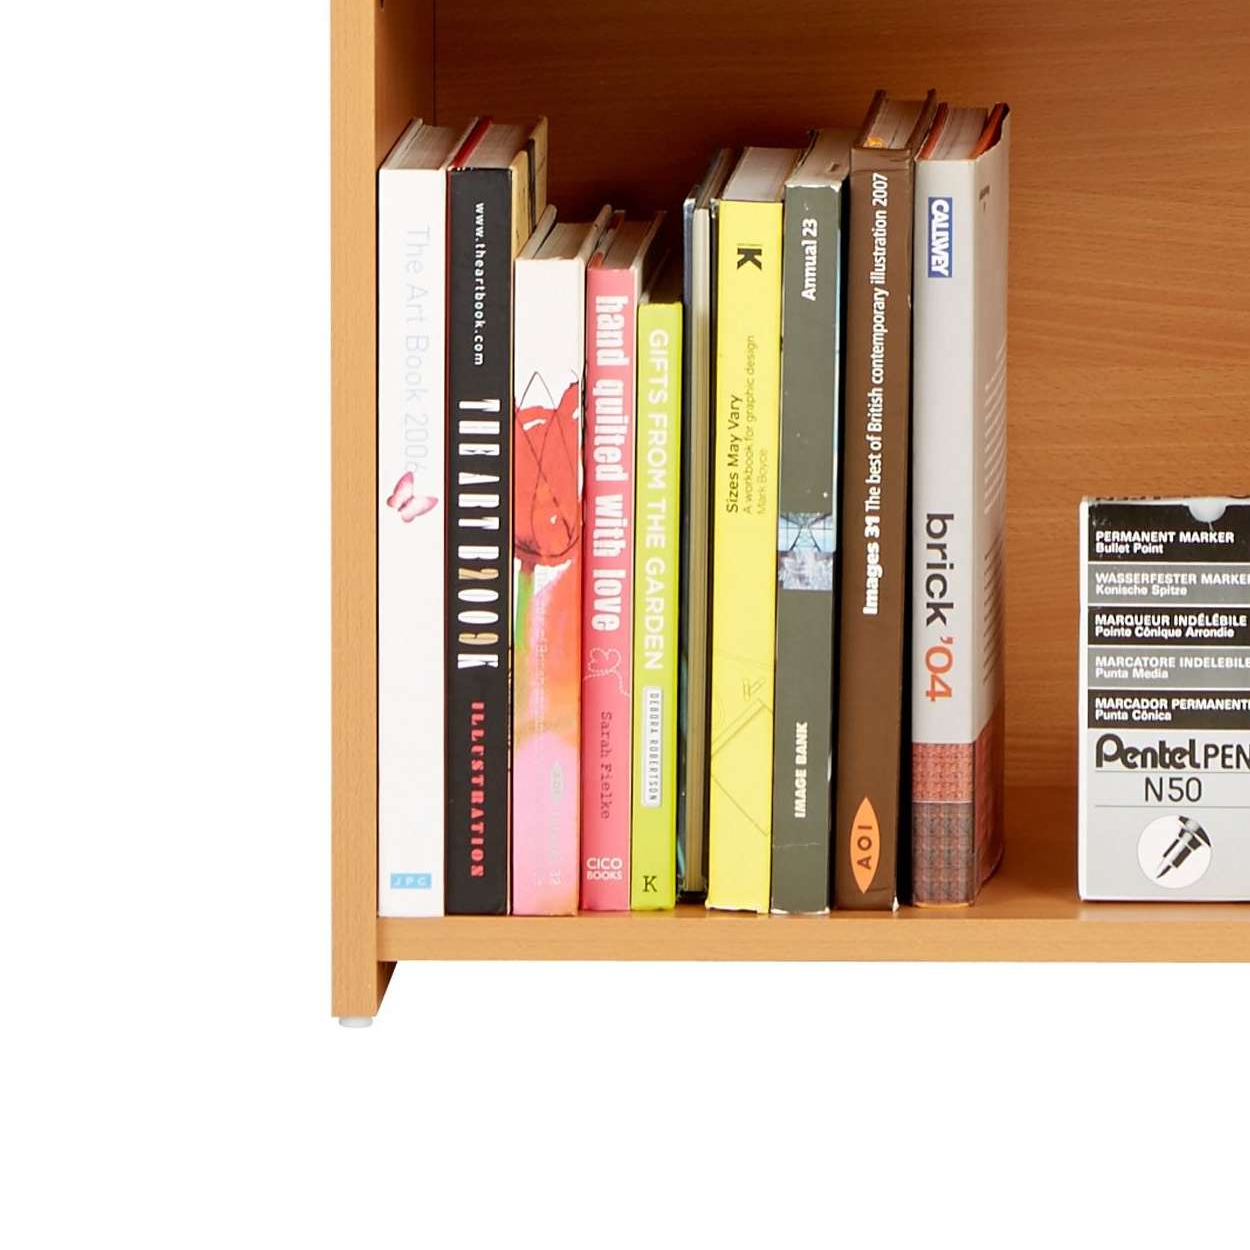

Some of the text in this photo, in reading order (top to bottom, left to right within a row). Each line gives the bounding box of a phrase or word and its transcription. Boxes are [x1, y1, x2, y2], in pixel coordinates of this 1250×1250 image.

[404, 225, 430, 275] The
[736, 247, 763, 270] K
[801, 218, 819, 300] Annual 23
[931, 199, 949, 277] CALLWEY
[404, 283, 429, 326] Art
[474, 202, 486, 366] www.theartbook.com
[404, 334, 429, 402] Book
[863, 173, 889, 615] Images 31 The best of British contemporary illustration 2007
[591, 296, 629, 632] hand quilted with love
[726, 394, 744, 514] Sizes May Vary
[644, 329, 669, 670] GIFTS FROM THE GARDEN
[457, 399, 500, 669] THE ART BOOK
[1095, 531, 1235, 544] PERMANENT MARKER
[1095, 542, 1164, 554] Bullet Point
[925, 513, 954, 627] brick
[1095, 573, 1198, 585] WASSERFESTER
[1095, 584, 1187, 598] Konische Spitze
[1095, 612, 1247, 627] MARQUEUR INDÉLÉBILE
[1095, 626, 1235, 640] Pointe Cônique Arrondie
[1095, 656, 1176, 668] MARCATORE
[1095, 668, 1169, 679] Punta Media
[1095, 698, 1168, 710] MARCADOR
[1095, 708, 1172, 721] Punta Cônica
[600, 711, 613, 820] Sarah Fielke
[794, 722, 808, 819] IMAGE BANK
[470, 702, 485, 877] ILLUSTRATION
[586, 857, 623, 870] CICO
[857, 824, 873, 870] AOI
[586, 870, 623, 881] BOOKS
[642, 876, 658, 892] K
